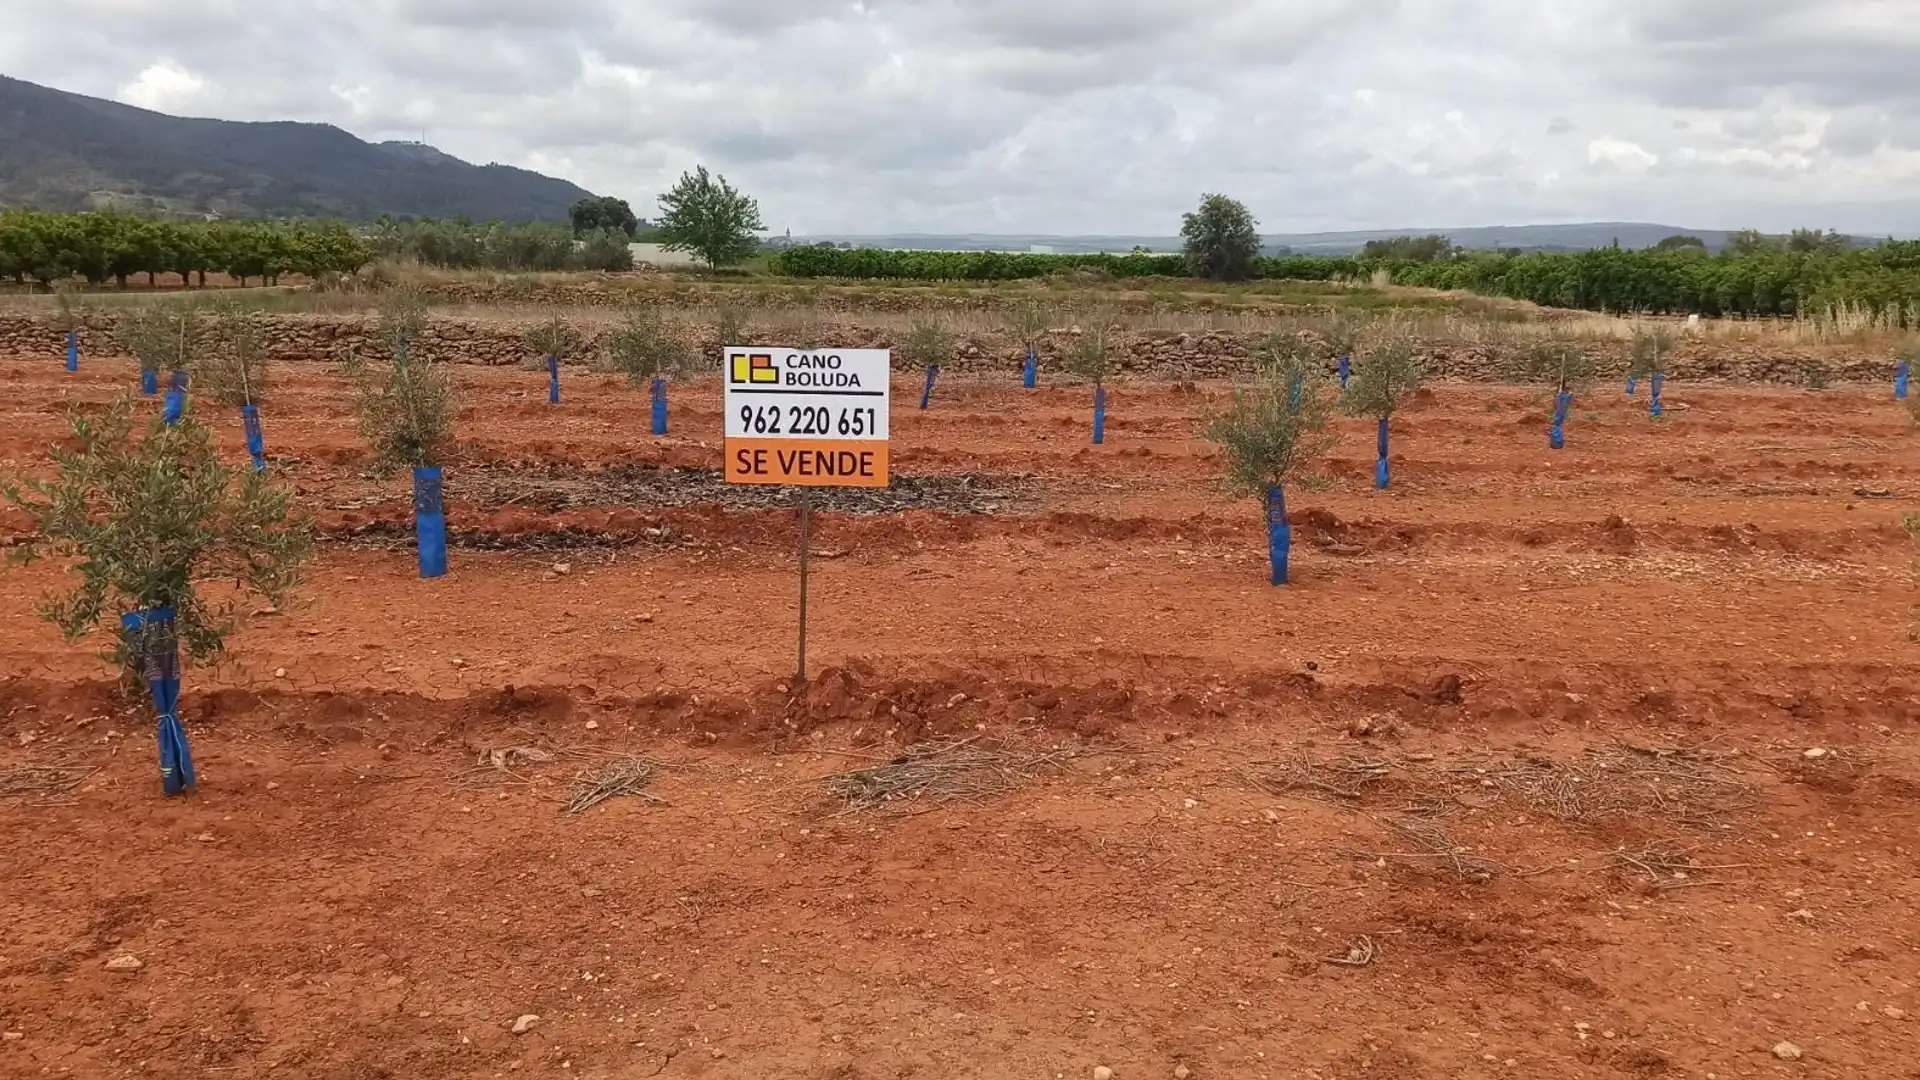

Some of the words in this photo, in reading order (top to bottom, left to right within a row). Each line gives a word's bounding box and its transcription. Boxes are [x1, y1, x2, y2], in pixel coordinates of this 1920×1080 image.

[786, 354, 842, 370] CANO
[785, 372, 861, 387] BOLUDA
[741, 405, 780, 434] 962
[789, 406, 830, 435] 220
[838, 408, 875, 436] 651
[736, 449, 768, 475] SE
[777, 450, 874, 476] VENDE
